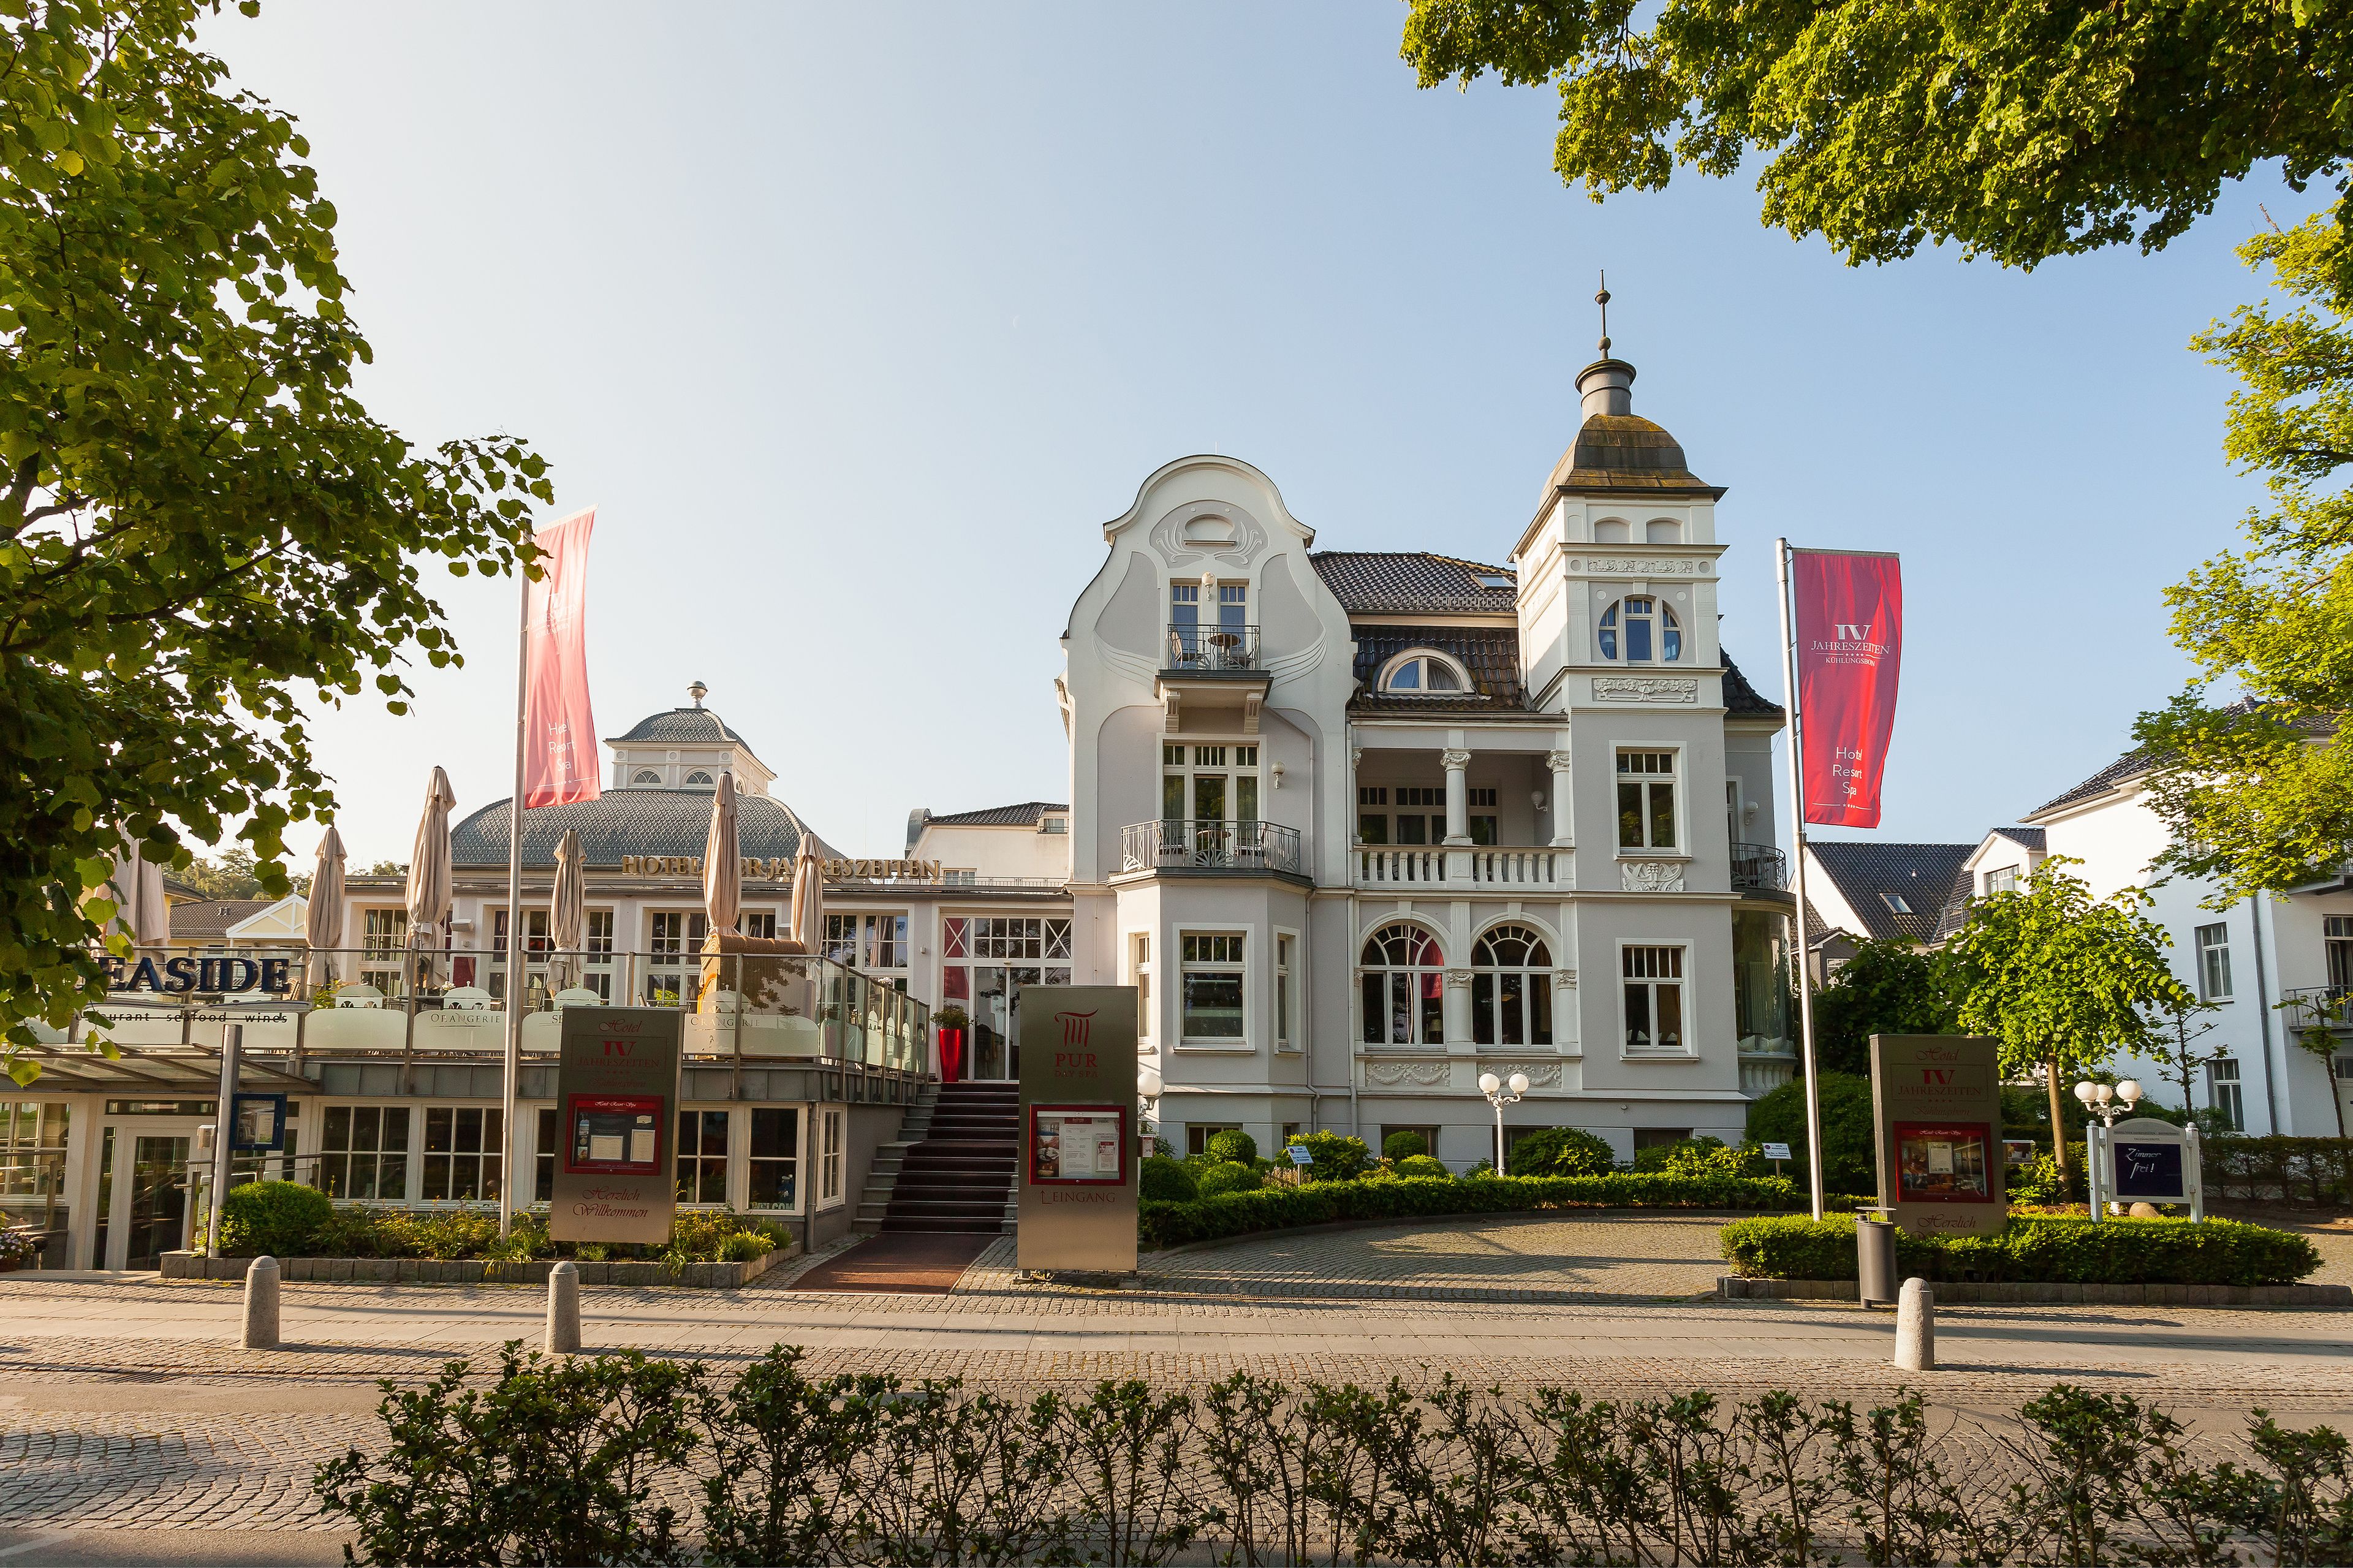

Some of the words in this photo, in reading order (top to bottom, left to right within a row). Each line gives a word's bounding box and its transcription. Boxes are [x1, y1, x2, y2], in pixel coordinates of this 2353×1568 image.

[1811, 640, 1891, 654] JAHRESZEITEN
[556, 758, 572, 776] Spa
[1842, 781, 1857, 799] Spa
[621, 855, 703, 876] HOTEL
[75, 956, 291, 994] EASIDE
[166, 1012, 227, 1023] seafood
[245, 1012, 288, 1023] wines
[598, 1018, 643, 1033] Hotel
[1055, 1053, 1097, 1067] PUR
[1915, 1047, 1960, 1061] Hotel
[2125, 1148, 2162, 1161] Zimmer
[582, 1186, 640, 1201] Herzlich
[1053, 1191, 1116, 1203] EINGANG
[572, 1203, 648, 1218] Willkommen
[1917, 1214, 1977, 1229] Herzlich
